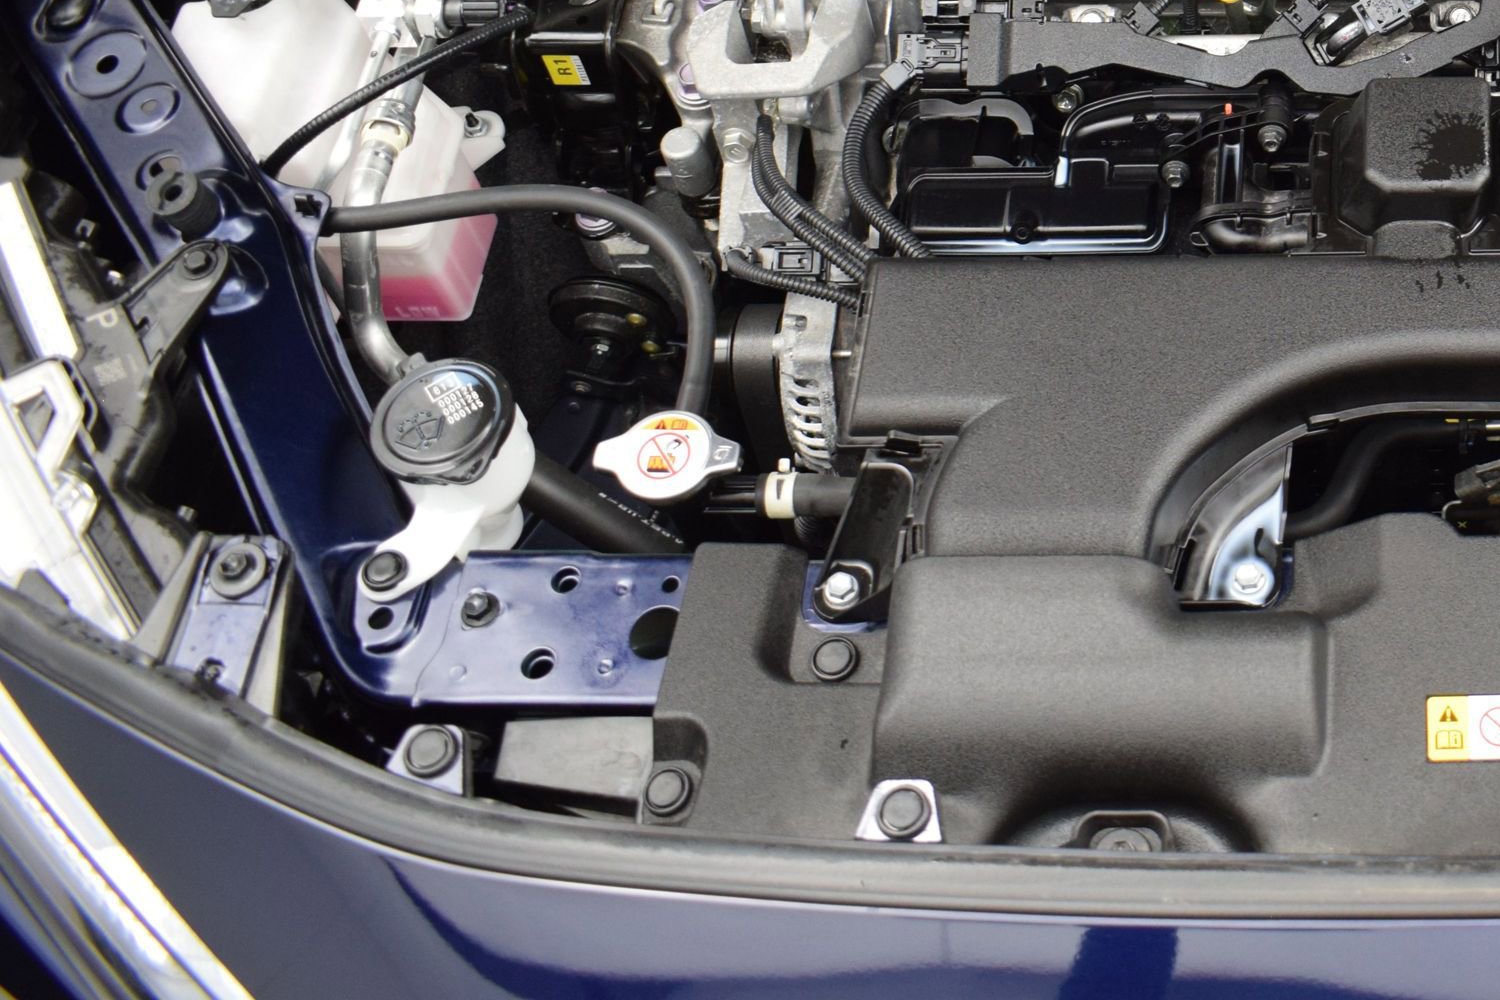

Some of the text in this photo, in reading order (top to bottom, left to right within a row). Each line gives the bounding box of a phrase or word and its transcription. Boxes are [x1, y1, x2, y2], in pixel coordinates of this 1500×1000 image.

[86, 308, 118, 328] P
[438, 383, 474, 408] 000127
[446, 400, 484, 425] 000145
